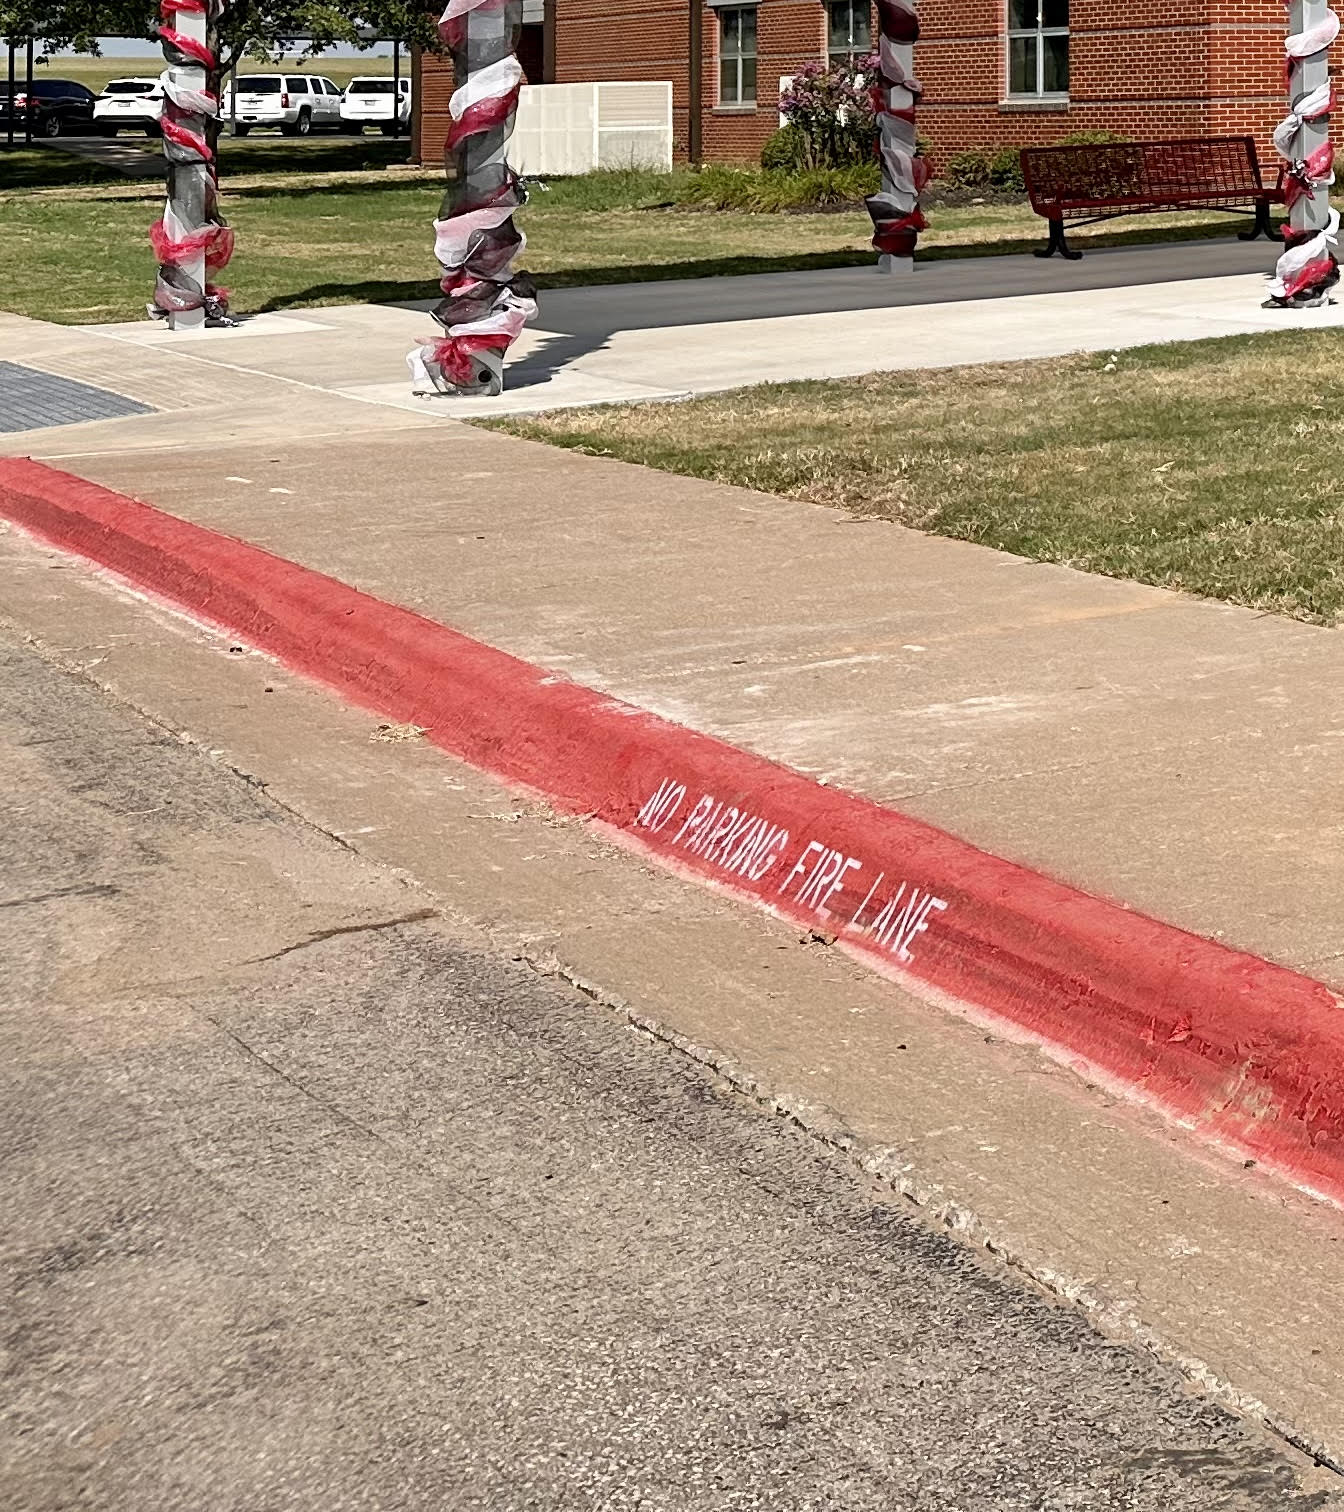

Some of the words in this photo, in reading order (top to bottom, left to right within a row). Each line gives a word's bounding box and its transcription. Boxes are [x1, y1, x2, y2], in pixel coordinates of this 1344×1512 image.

[633, 776, 687, 834] NO
[671, 794, 789, 881] PARKING
[777, 840, 863, 920] FIRE
[843, 871, 949, 964] LANE
